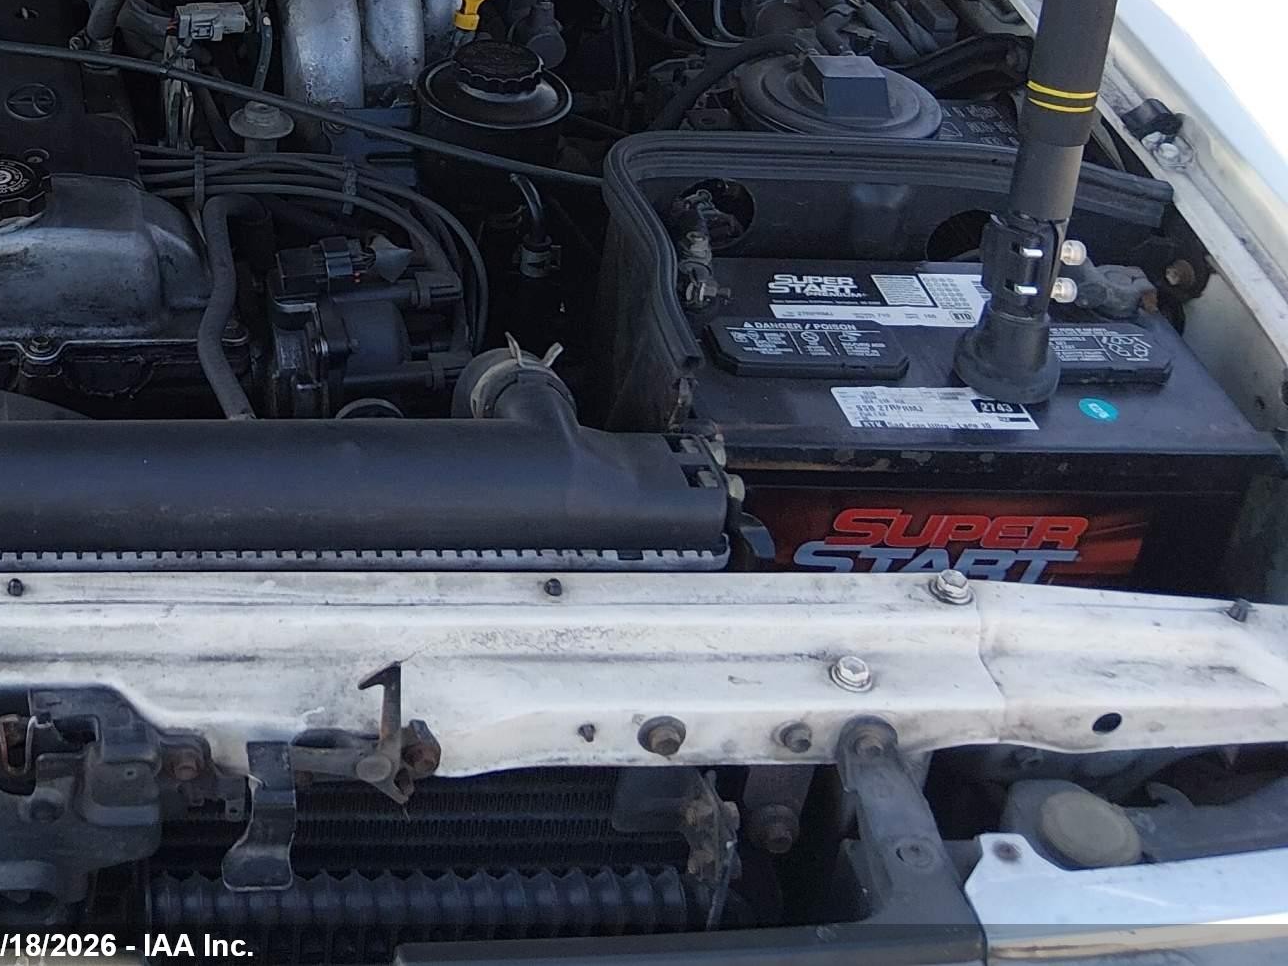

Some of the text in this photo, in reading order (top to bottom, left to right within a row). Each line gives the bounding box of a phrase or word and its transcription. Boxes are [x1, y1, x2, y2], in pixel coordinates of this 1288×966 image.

[773, 274, 854, 286] SUPER
[768, 283, 858, 294] START
[754, 321, 803, 330] DANGER
[814, 323, 857, 331] POISON
[824, 508, 1089, 550] SUPER
[793, 540, 1080, 584] START
